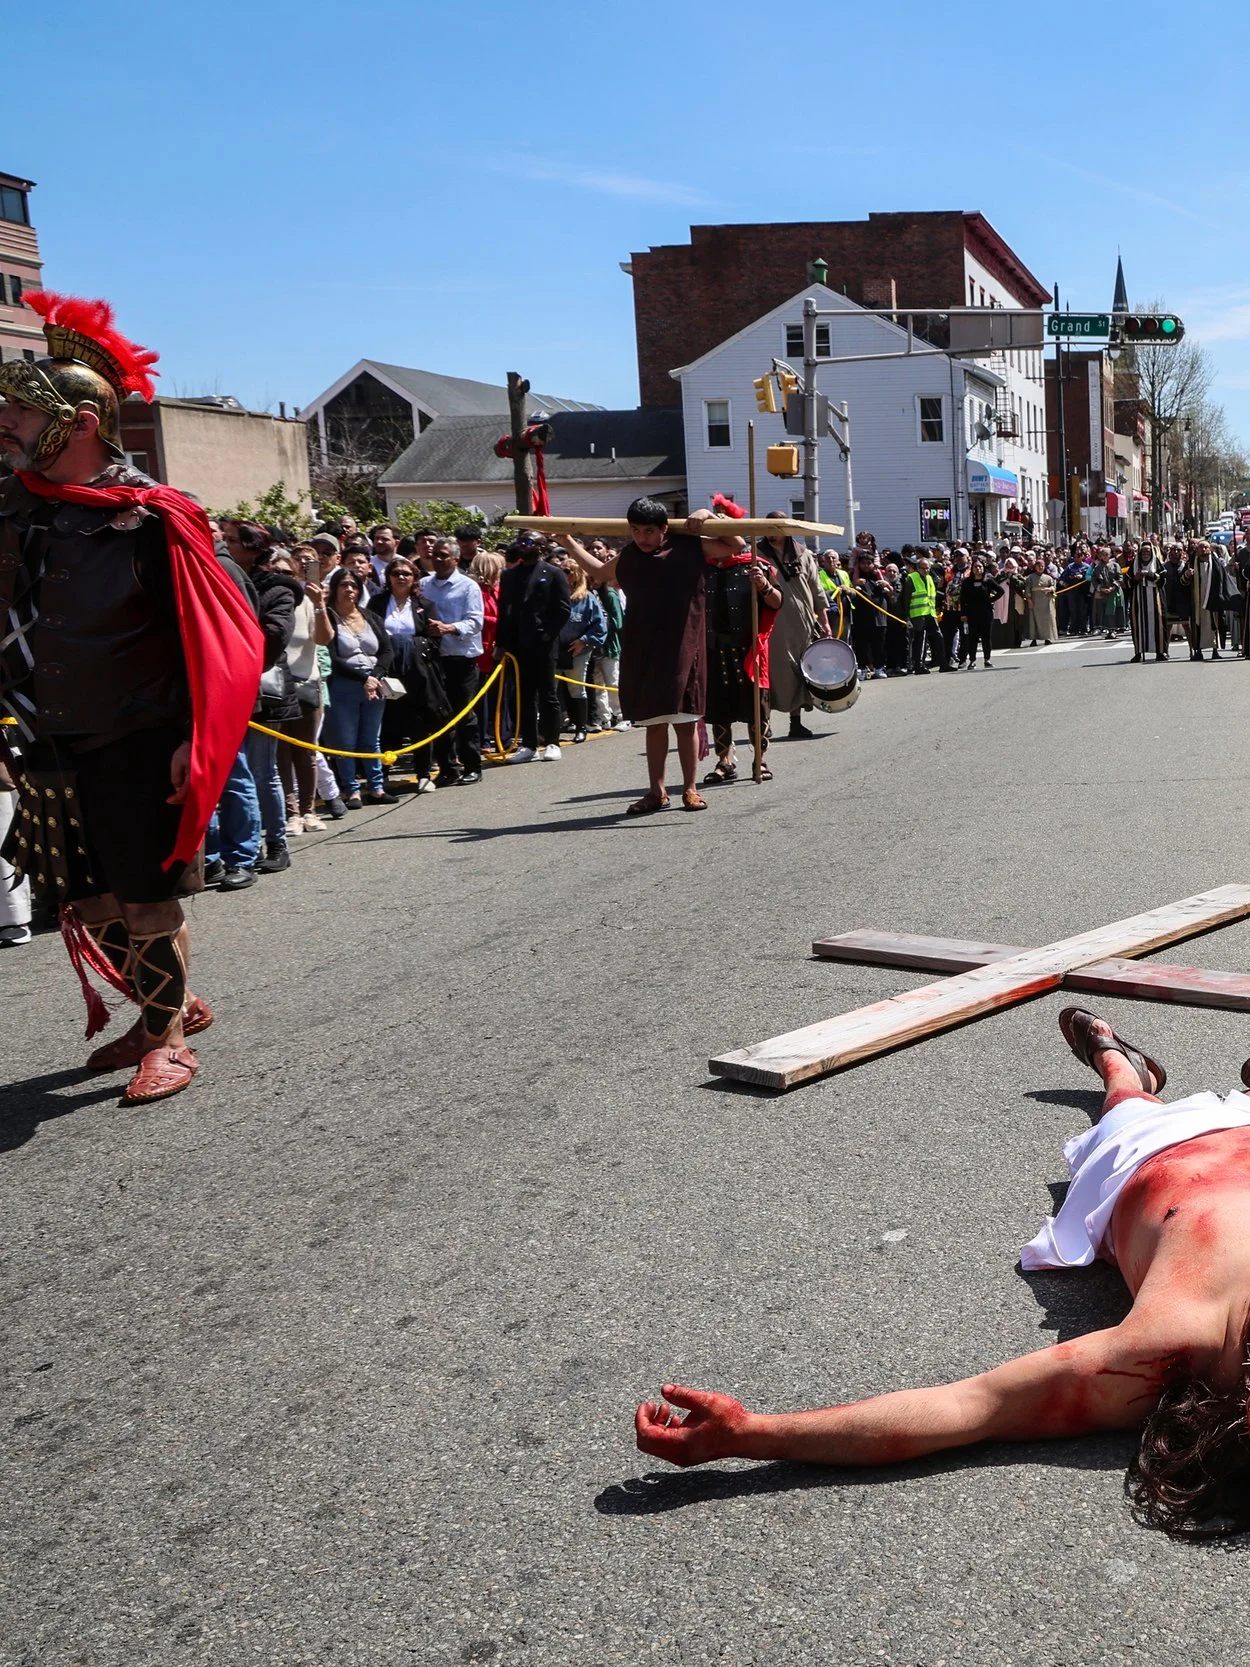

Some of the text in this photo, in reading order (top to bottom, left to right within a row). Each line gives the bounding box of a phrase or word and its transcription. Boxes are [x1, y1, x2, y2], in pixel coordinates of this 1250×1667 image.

[1051, 320, 1106, 332] Grand St
[923, 508, 950, 520] OPEN
